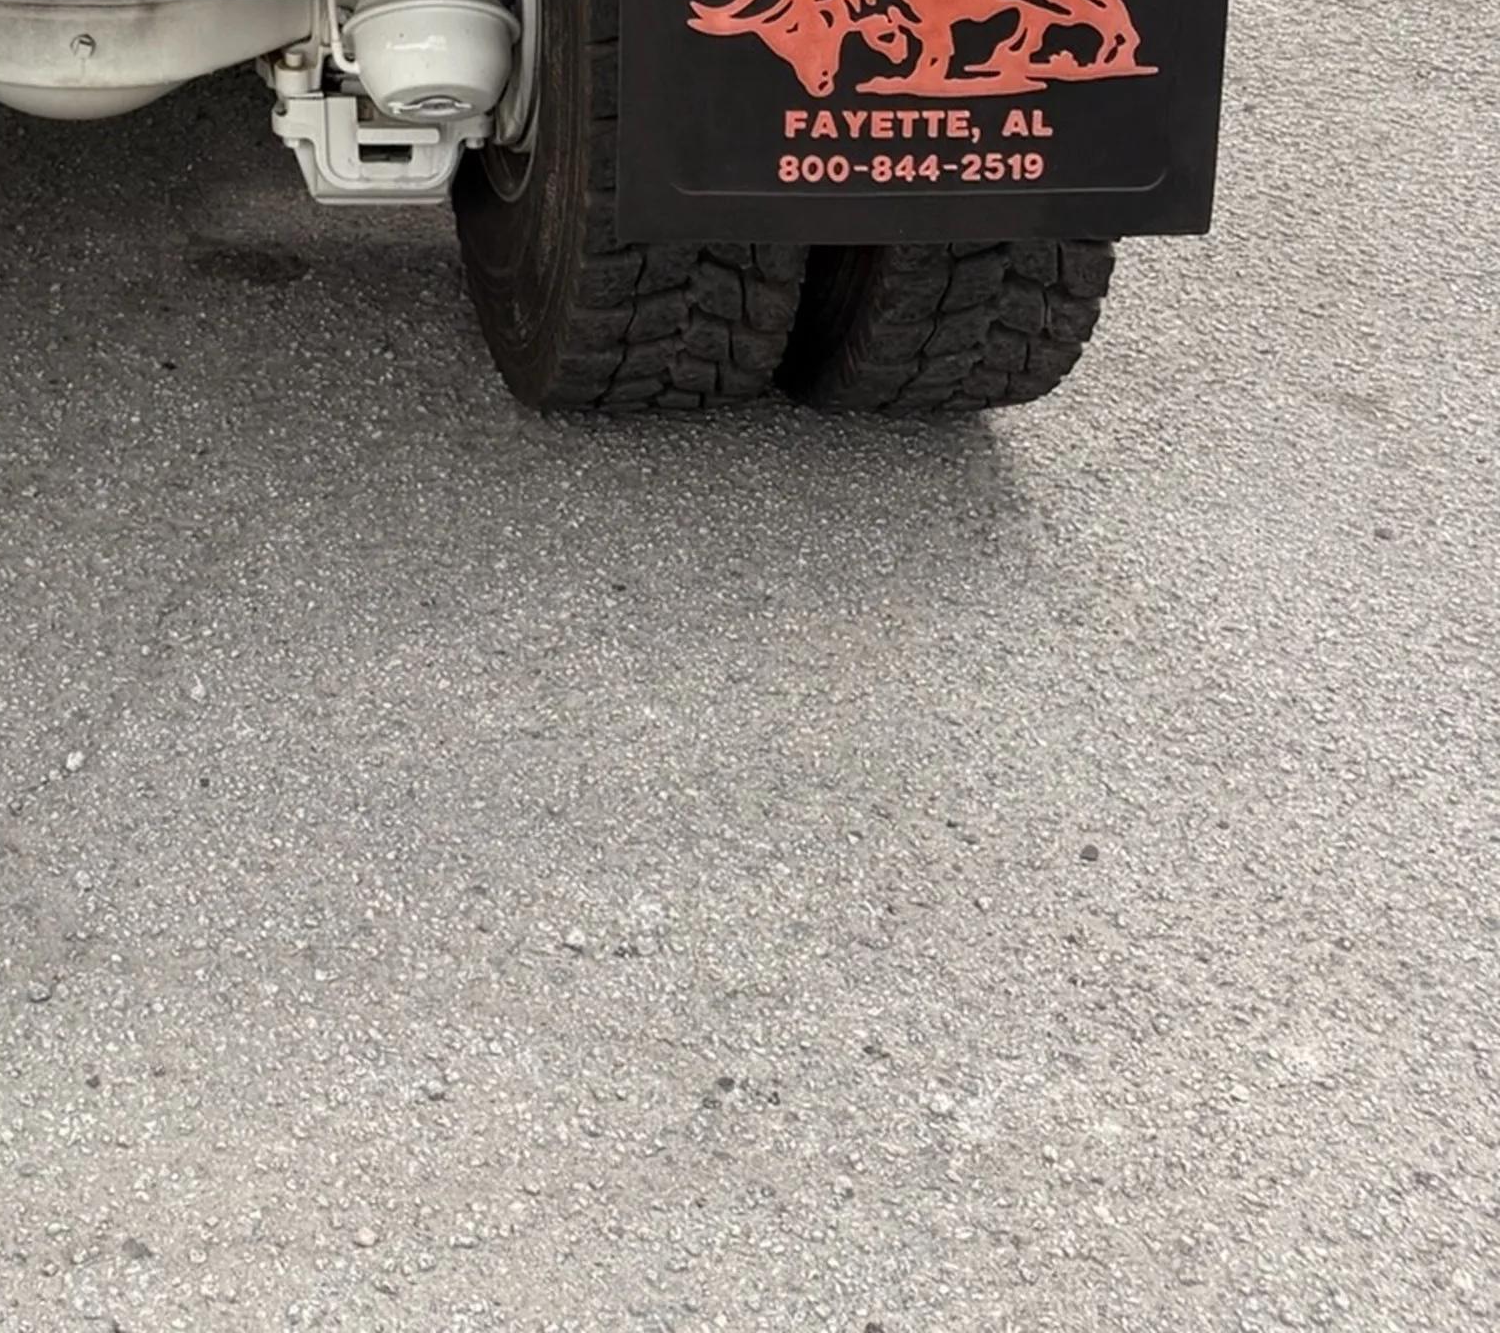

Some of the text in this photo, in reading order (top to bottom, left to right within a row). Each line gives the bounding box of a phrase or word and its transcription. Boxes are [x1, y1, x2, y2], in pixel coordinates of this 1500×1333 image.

[784, 108, 1053, 144] FAYETTE, AL
[778, 151, 1046, 183] 800-844-2519
